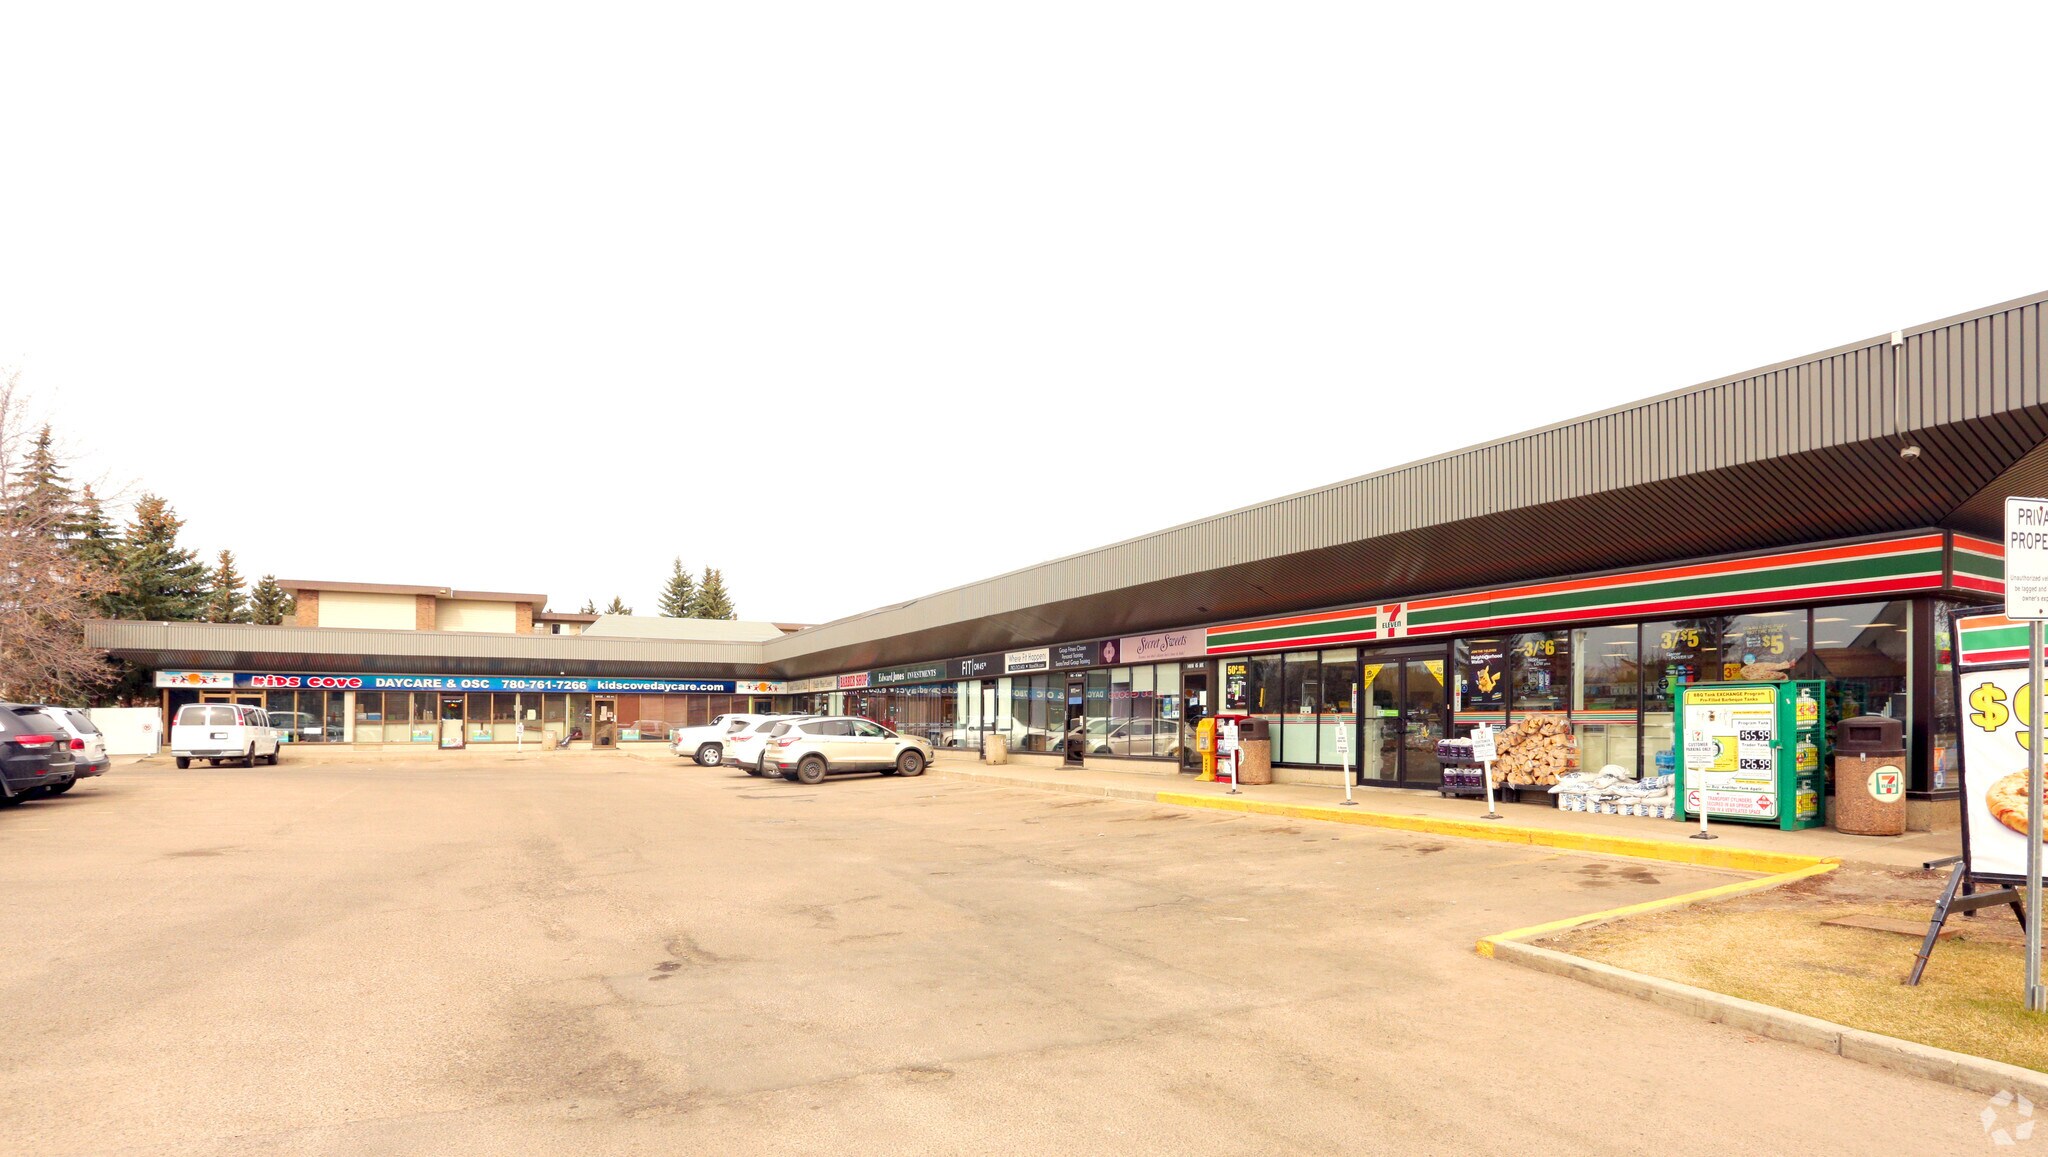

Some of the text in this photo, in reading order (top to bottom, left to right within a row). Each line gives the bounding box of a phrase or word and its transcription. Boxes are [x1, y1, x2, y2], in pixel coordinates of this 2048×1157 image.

[1136, 634, 1187, 654] Secret Sweets
[961, 661, 971, 675] FIT
[878, 672, 893, 682] Edward
[907, 669, 937, 679] INVESTMENTS
[375, 678, 724, 692] DAYCARE & OSC 780-761-7266 kidscovedaycare.com
[1741, 730, 1770, 741] $65.99
[1741, 759, 1771, 770] $26.99
